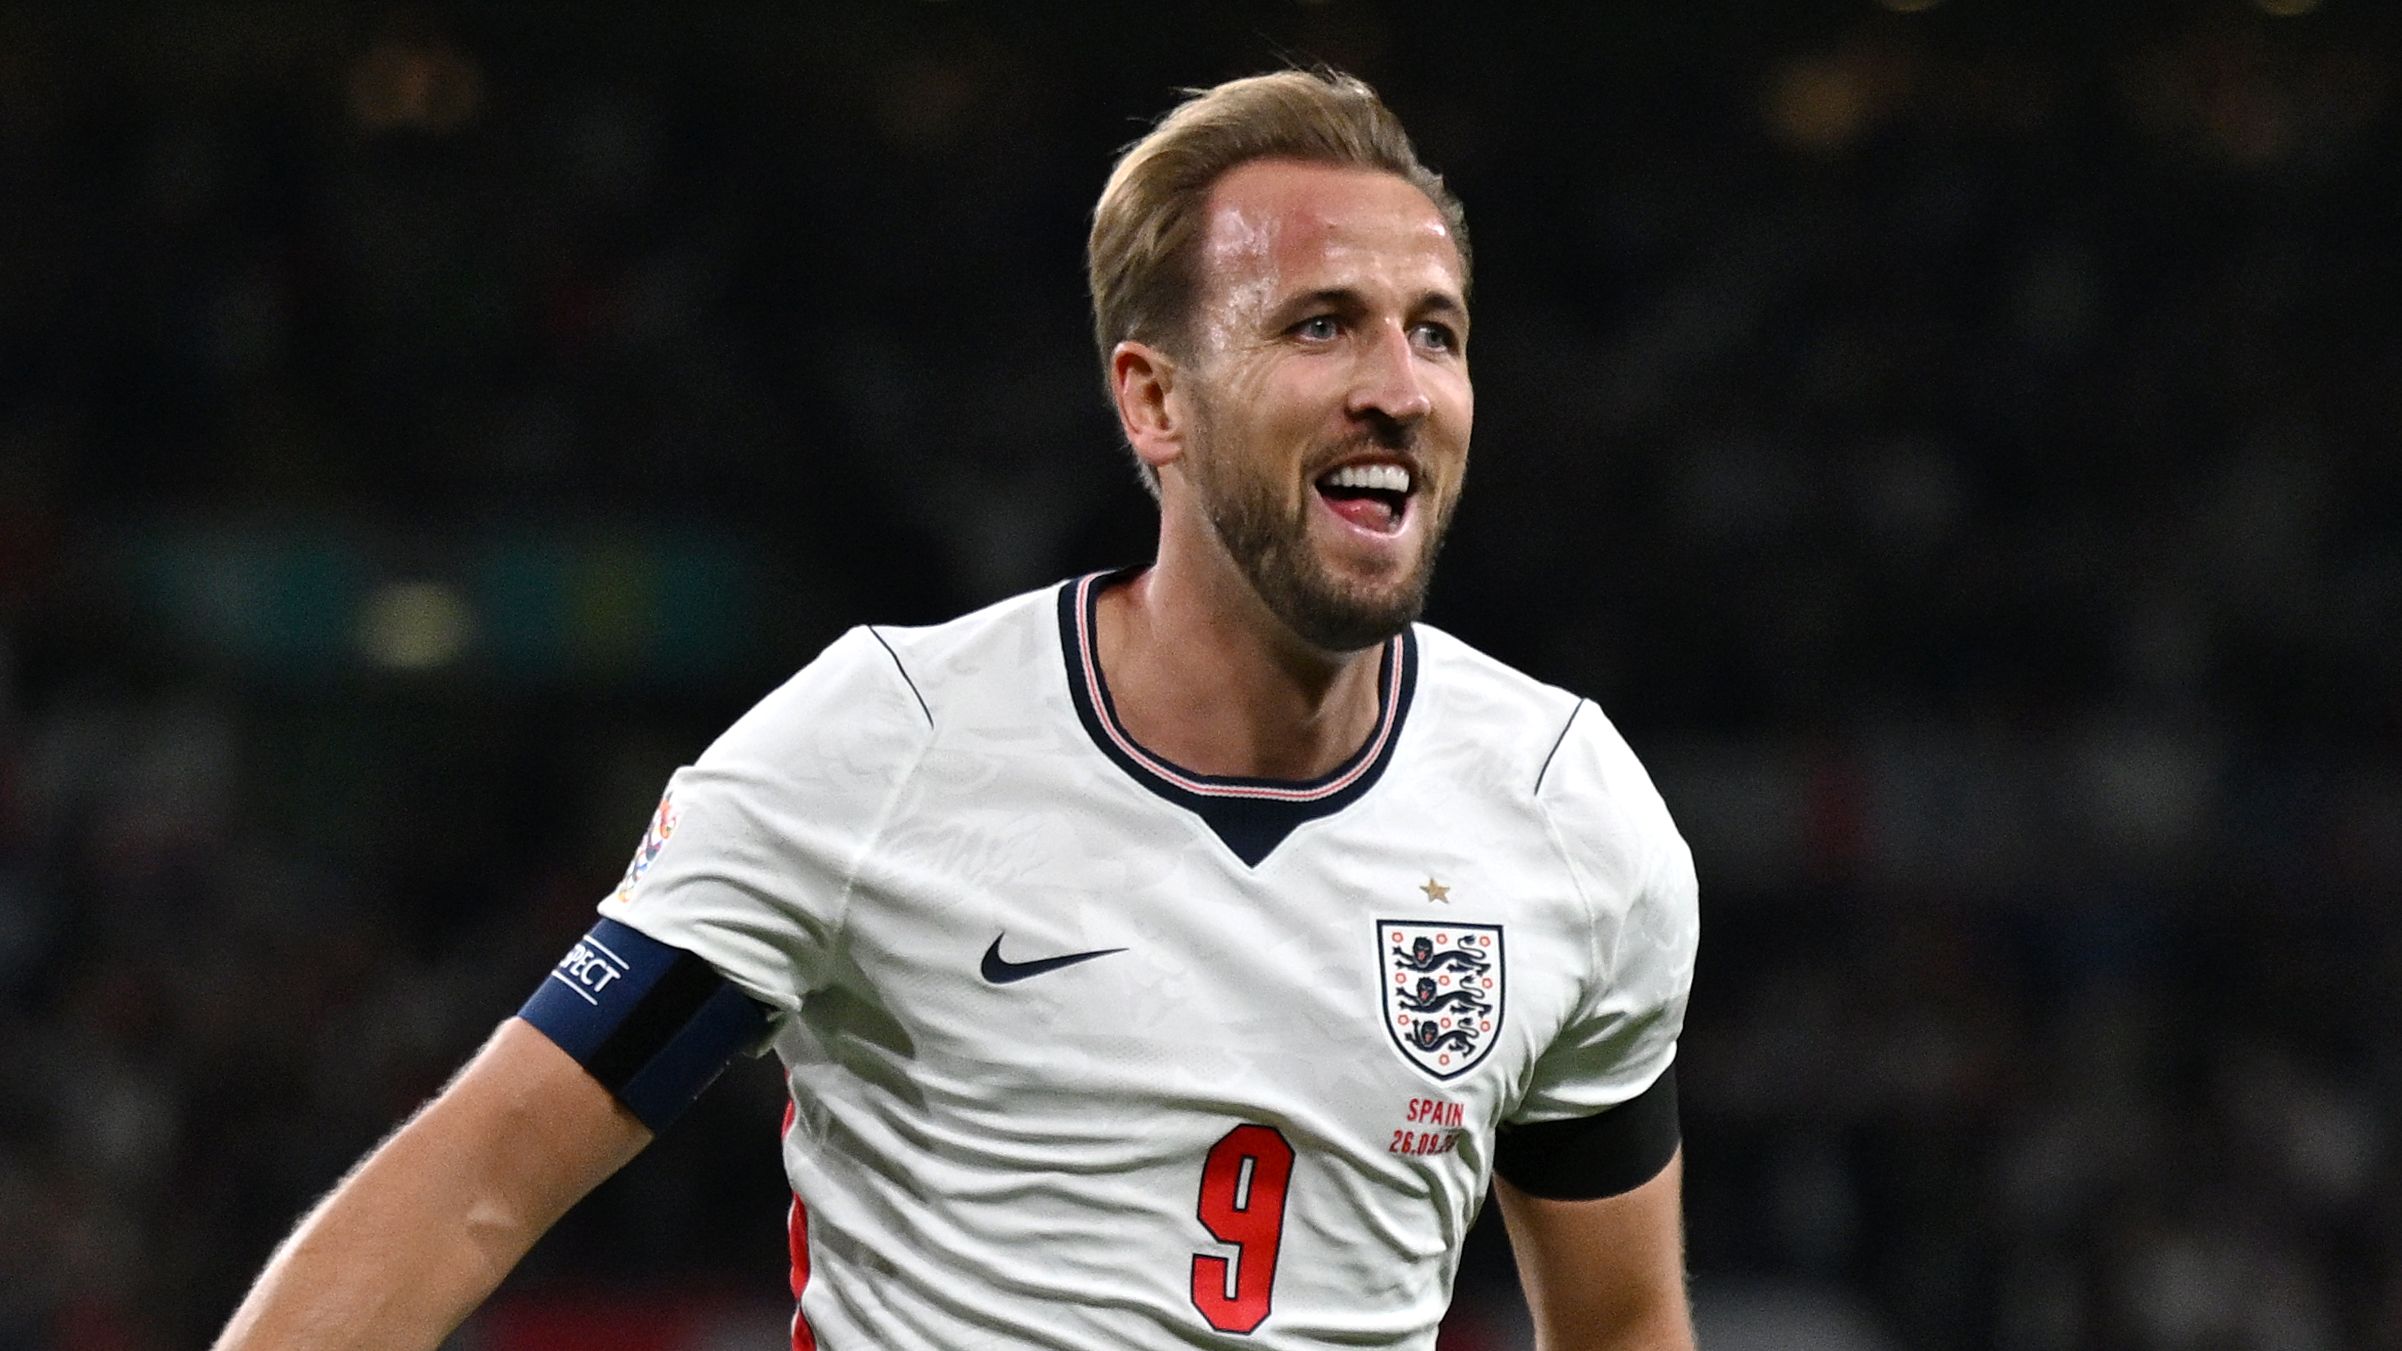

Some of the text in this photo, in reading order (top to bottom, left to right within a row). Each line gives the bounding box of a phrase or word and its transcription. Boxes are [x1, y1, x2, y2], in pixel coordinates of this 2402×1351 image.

[1407, 1098, 1465, 1127] SPAIN
[1388, 1129, 1462, 1156] 26.09.
[1190, 1123, 1296, 1336] 9
